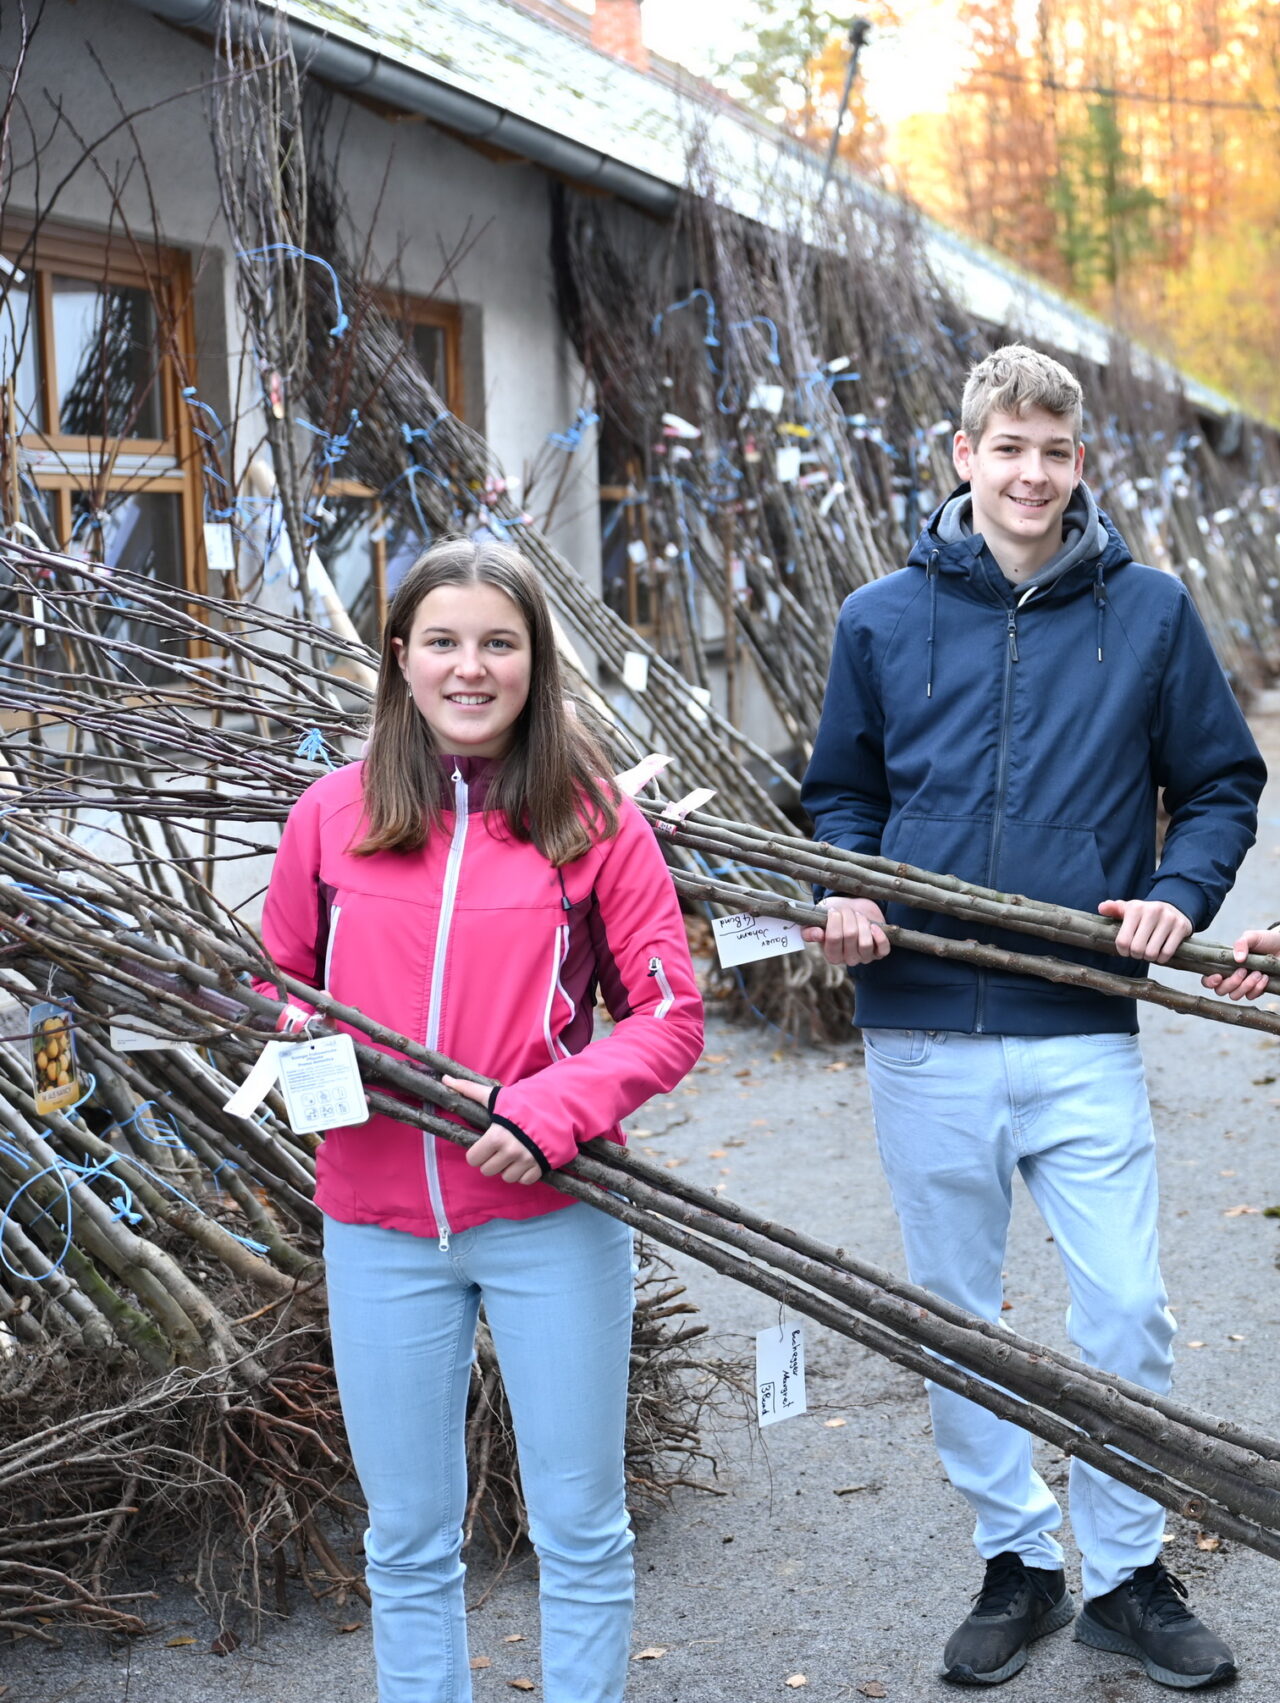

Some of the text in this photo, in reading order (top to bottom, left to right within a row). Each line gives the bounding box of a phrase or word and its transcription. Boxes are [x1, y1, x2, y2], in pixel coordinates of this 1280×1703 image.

[743, 914, 752, 925] 4
[737, 928, 769, 940] Johann
[761, 936, 788, 947] Bauer
